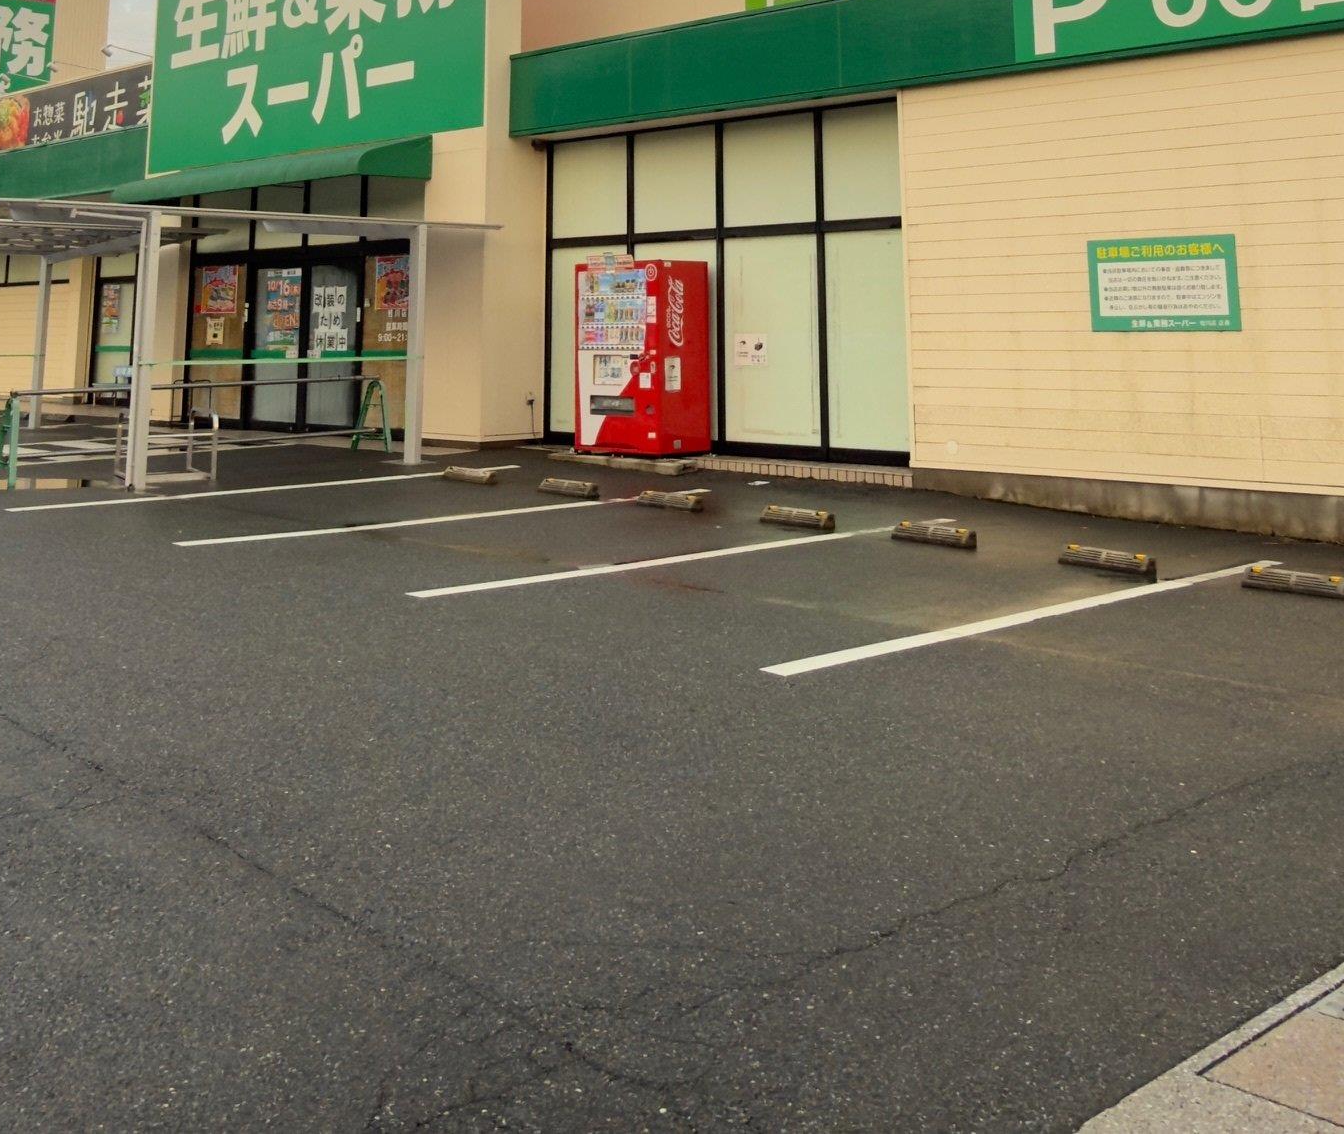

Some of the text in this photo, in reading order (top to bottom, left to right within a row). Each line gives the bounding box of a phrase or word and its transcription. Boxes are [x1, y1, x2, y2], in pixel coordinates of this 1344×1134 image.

[221, 34, 414, 145] スーパー
[314, 294, 345, 308] 改装の
[320, 315, 341, 327] ため
